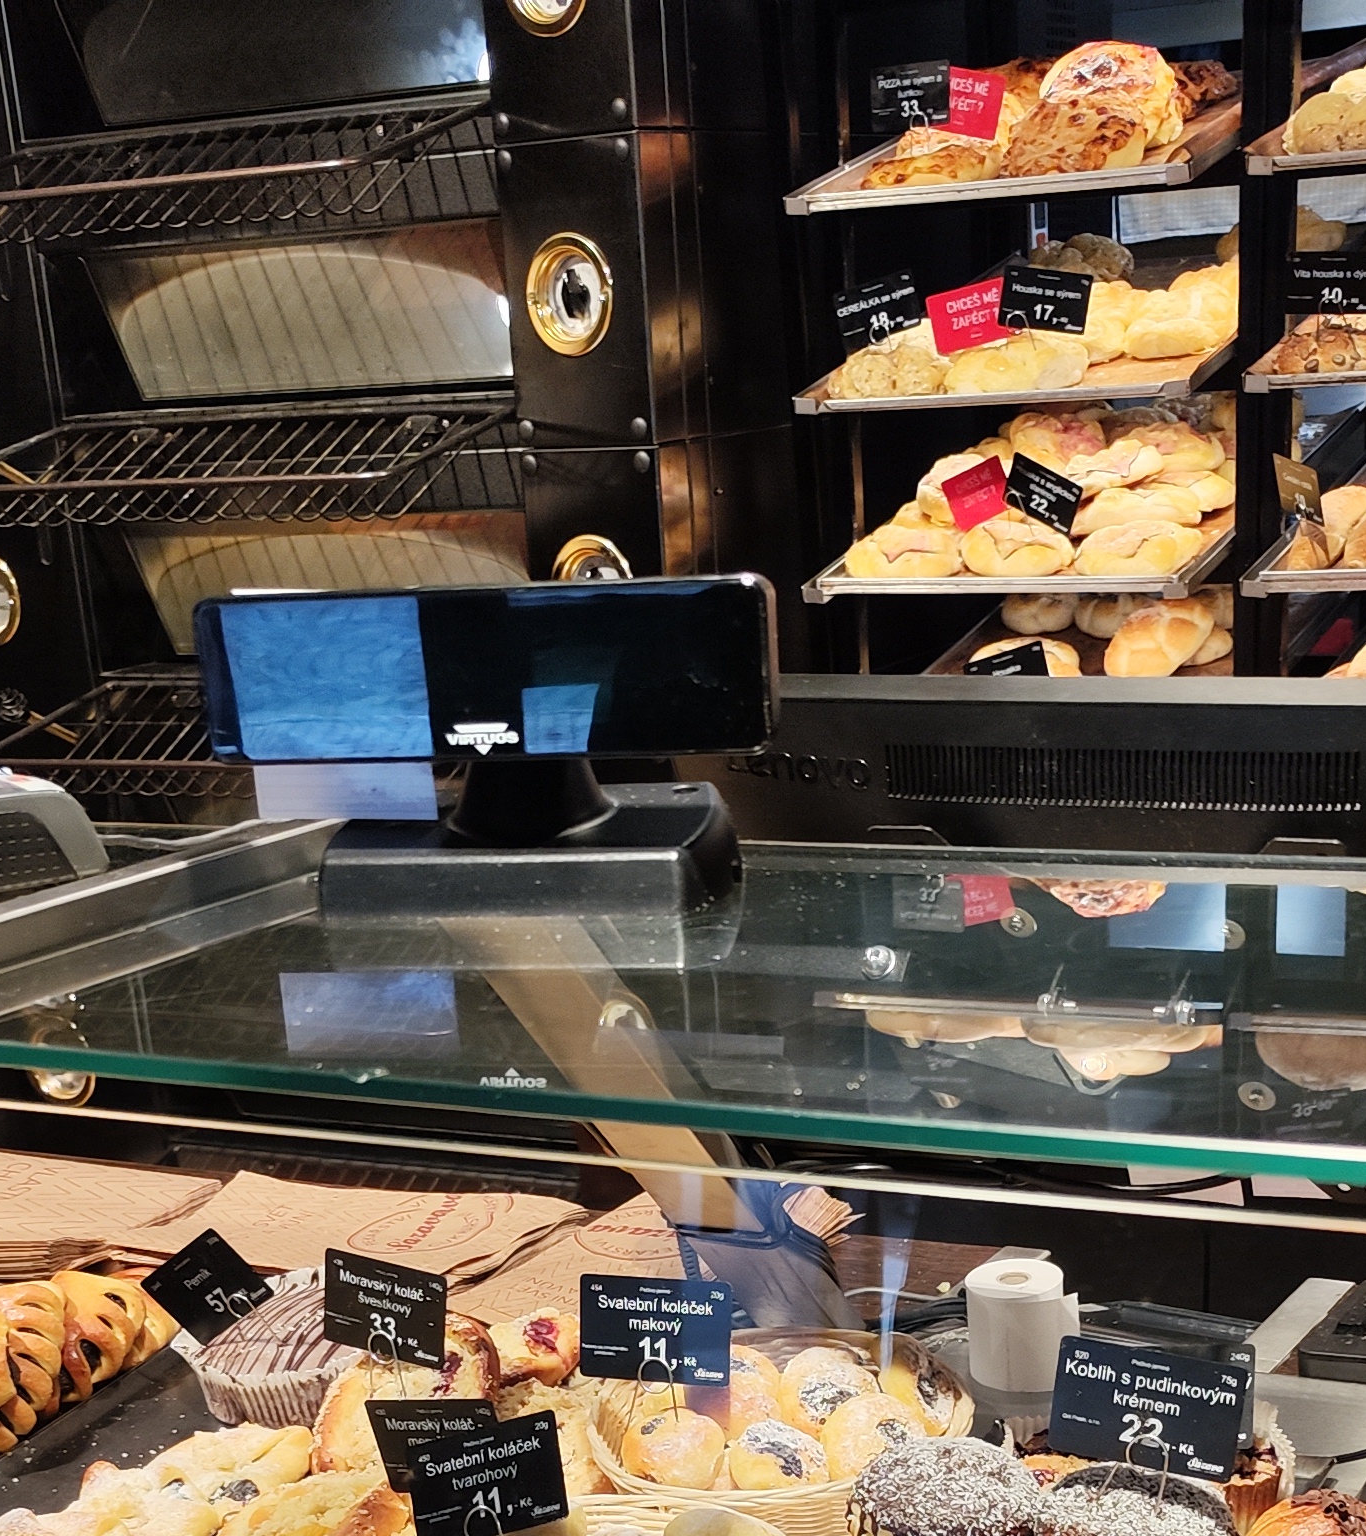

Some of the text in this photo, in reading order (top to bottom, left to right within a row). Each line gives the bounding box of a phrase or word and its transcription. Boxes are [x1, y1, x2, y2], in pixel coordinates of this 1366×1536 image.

[946, 292, 981, 314] CHCEŠ
[444, 730, 519, 746] VIRTUOS
[183, 1269, 213, 1291] Perník
[339, 1268, 424, 1302] Moravský koláč
[357, 1291, 412, 1318] švestkový
[597, 1294, 713, 1316] Svatební koláček
[629, 1317, 682, 1336] makový
[1121, 1372, 1131, 1386] s
[1135, 1375, 1236, 1406] pudinkovým
[1220, 1374, 1237, 1388] 75g
[1113, 1389, 1181, 1416] krémem
[385, 1418, 475, 1433] Moravský koláč
[425, 1436, 541, 1477] Svatební koláček
[452, 1462, 518, 1491] tvarohový
